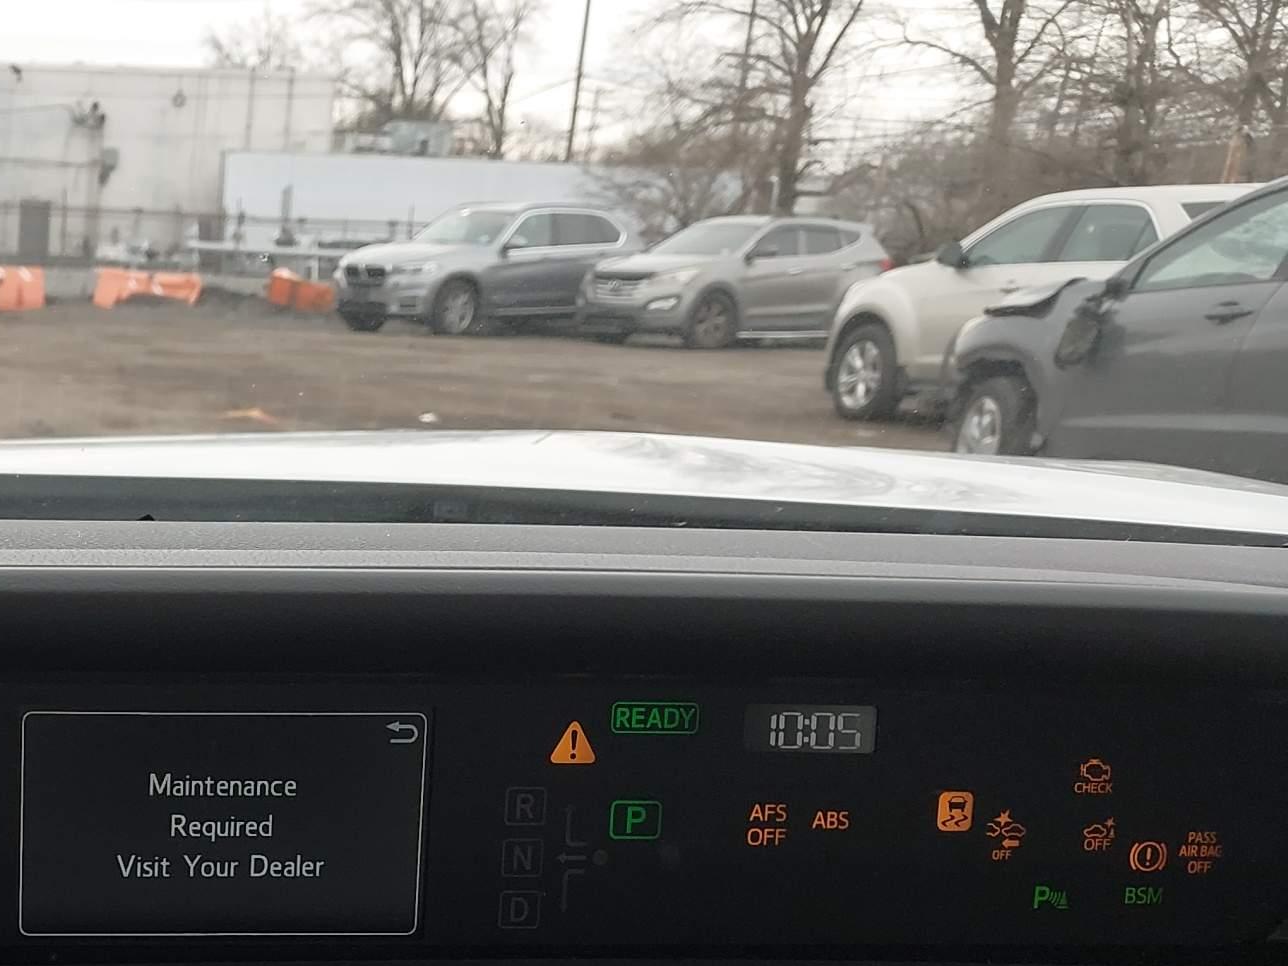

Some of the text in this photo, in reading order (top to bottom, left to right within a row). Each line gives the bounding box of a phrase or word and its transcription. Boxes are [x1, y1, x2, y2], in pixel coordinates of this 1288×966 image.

[615, 707, 695, 730] READY
[769, 711, 861, 750] 10:05
[148, 773, 297, 798] Maintenance
[1074, 782, 1112, 794] CHECK
[515, 793, 536, 819] R
[749, 803, 788, 822] AFS
[170, 814, 274, 842] Required
[625, 806, 647, 834] P
[812, 811, 850, 830] ABS
[747, 828, 787, 846] OFF
[1083, 838, 1112, 852] OFF
[1187, 831, 1218, 844] PASS
[512, 845, 534, 871] N
[991, 849, 1012, 861] OFF
[1178, 844, 1198, 857] AIR
[116, 854, 325, 878] Visit Your Dealer
[1187, 860, 1214, 874] OFF
[1124, 886, 1163, 906] BSM
[510, 897, 531, 923] D
